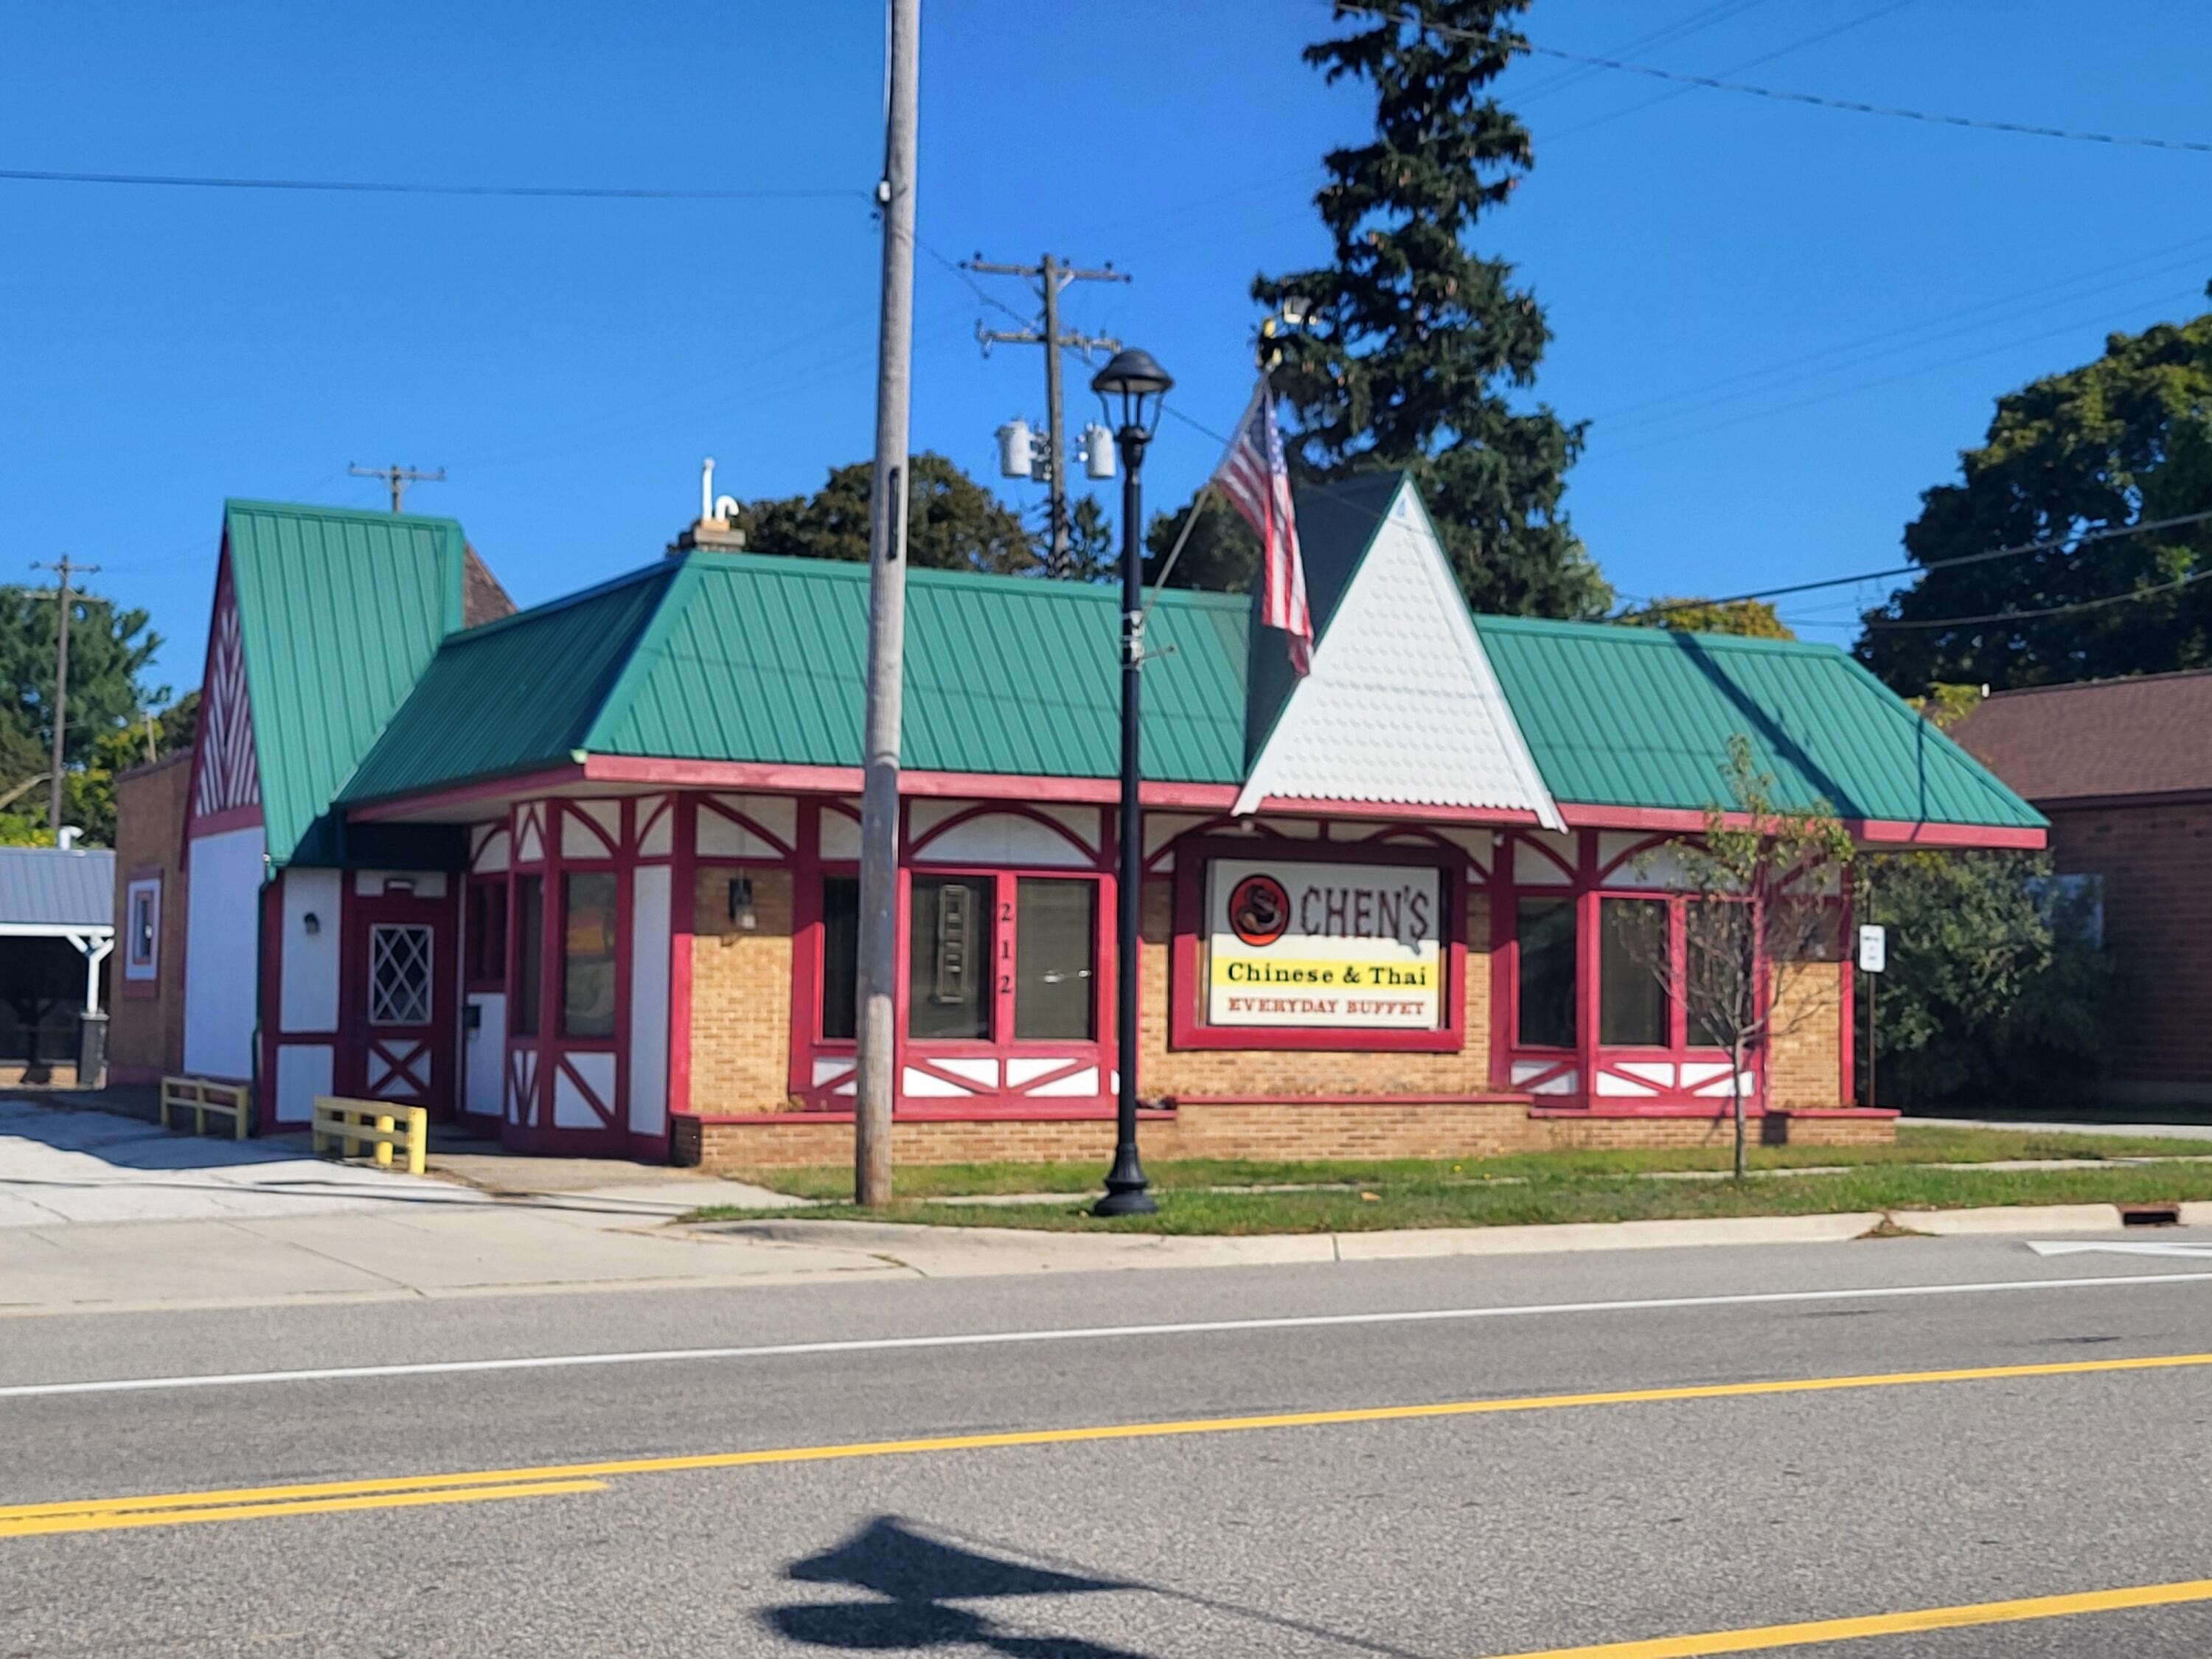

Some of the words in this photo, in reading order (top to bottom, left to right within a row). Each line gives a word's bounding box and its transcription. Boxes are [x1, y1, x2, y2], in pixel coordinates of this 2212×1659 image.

[1301, 886, 1430, 942] CHEN'S
[1228, 961, 1334, 983] Chinese
[1343, 967, 1361, 984] &
[1368, 967, 1427, 986] Thai
[1228, 997, 1340, 1015] EVERYDAY
[1346, 1000, 1425, 1016] BUFFET
